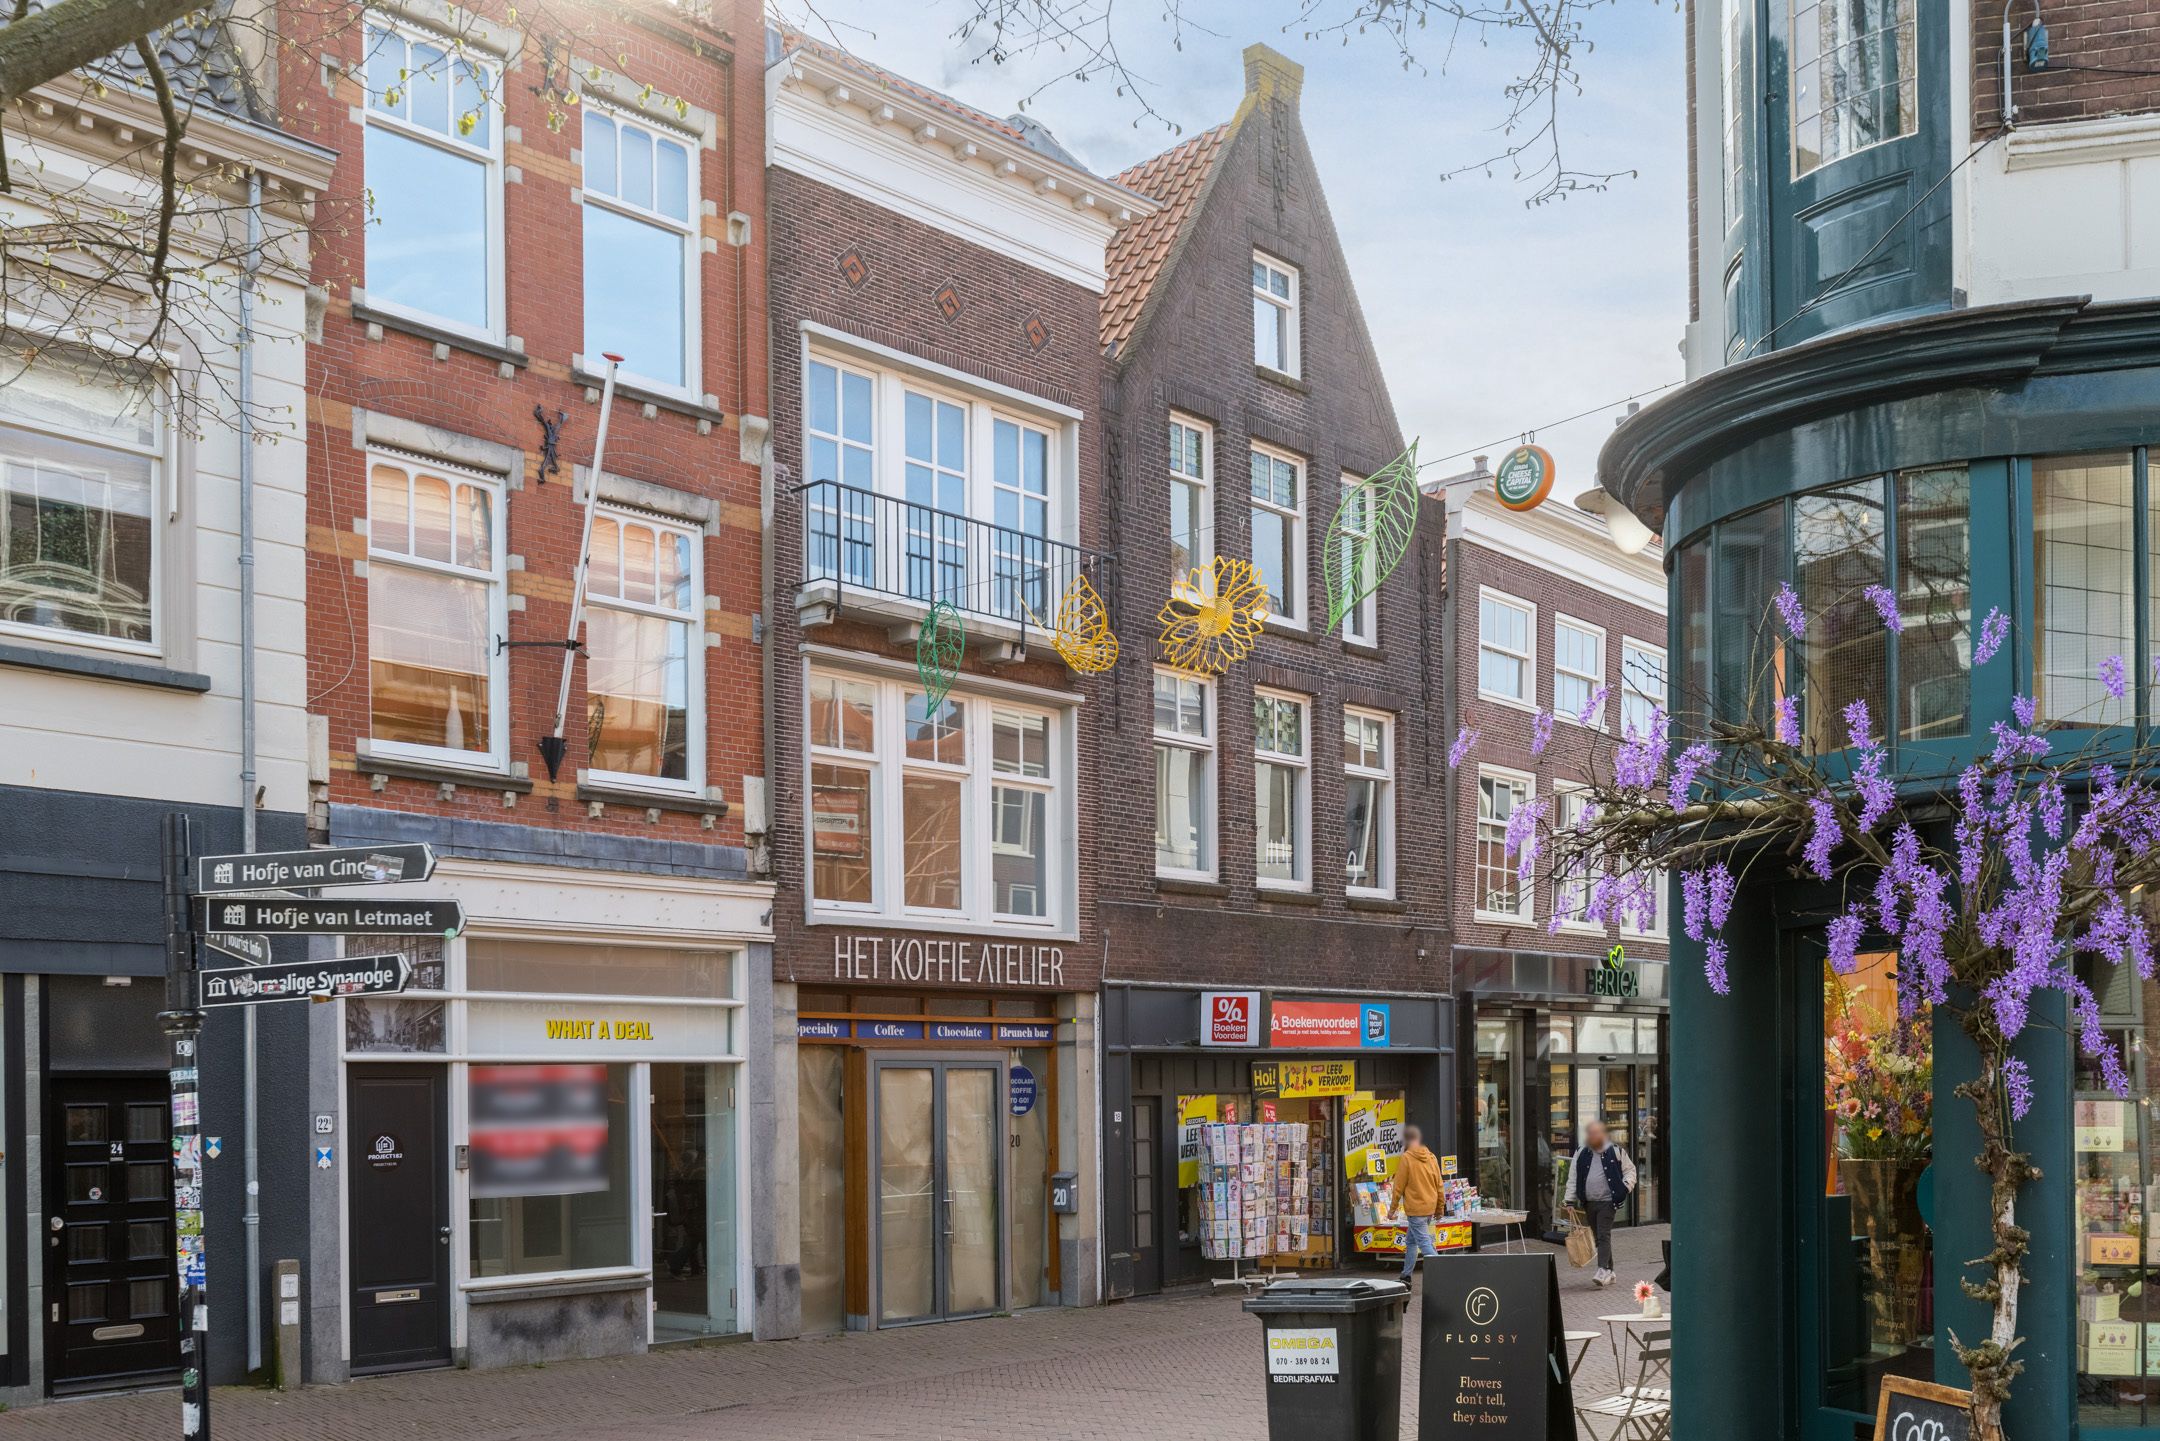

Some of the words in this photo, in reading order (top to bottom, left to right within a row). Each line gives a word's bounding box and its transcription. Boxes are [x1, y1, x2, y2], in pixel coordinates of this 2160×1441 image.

[1508, 469, 1532, 478] CHEESE
[1506, 477, 1531, 486] CAPITAL
[242, 862, 289, 884] Hofje
[293, 864, 325, 878] van
[256, 908, 309, 928] Hofje
[314, 912, 349, 925] van
[355, 909, 433, 926] Letmaet
[834, 935, 883, 979] HET
[891, 937, 971, 982] KOFFIE
[977, 943, 1064, 986] ATELIER
[318, 969, 393, 990] Synagoge
[1593, 968, 1640, 997] ERICA
[1213, 1023, 1246, 1032] Boeken
[1281, 1015, 1358, 1029] Boekenvoordeel
[546, 1019, 594, 1040] WHAT
[599, 1020, 611, 1039] A
[614, 1020, 653, 1041] DEAL
[874, 1023, 905, 1036] Coffee
[937, 1025, 982, 1037] Chocolate
[1000, 1026, 1033, 1038] Brunch
[1034, 1026, 1049, 1038] bar
[1213, 1031, 1246, 1040] Voordeel
[1326, 1064, 1344, 1075] LEEG
[1253, 1067, 1277, 1087] Hoi!
[1318, 1074, 1352, 1087] VERKOOP!
[1114, 1112, 1121, 1121] 18
[1350, 1118, 1368, 1136] LEEG-
[1010, 1134, 1021, 1148] 20
[1346, 1127, 1375, 1152] VERKOOP
[1380, 1128, 1397, 1143] LEEG-
[111, 1143, 123, 1154] 24
[1053, 1188, 1067, 1206] 20
[1270, 1337, 1335, 1349] OMEGA
[1445, 1333, 1518, 1344] FLOSSY
[1321, 1357, 1330, 1365] 24
[1273, 1375, 1336, 1383] BEDRIJFSAFVAL
[1460, 1376, 1502, 1389] Flowers
[1456, 1393, 1482, 1405] don't
[1486, 1394, 1506, 1407] tell,
[1453, 1411, 1476, 1426] they
[1479, 1411, 1508, 1424] show
